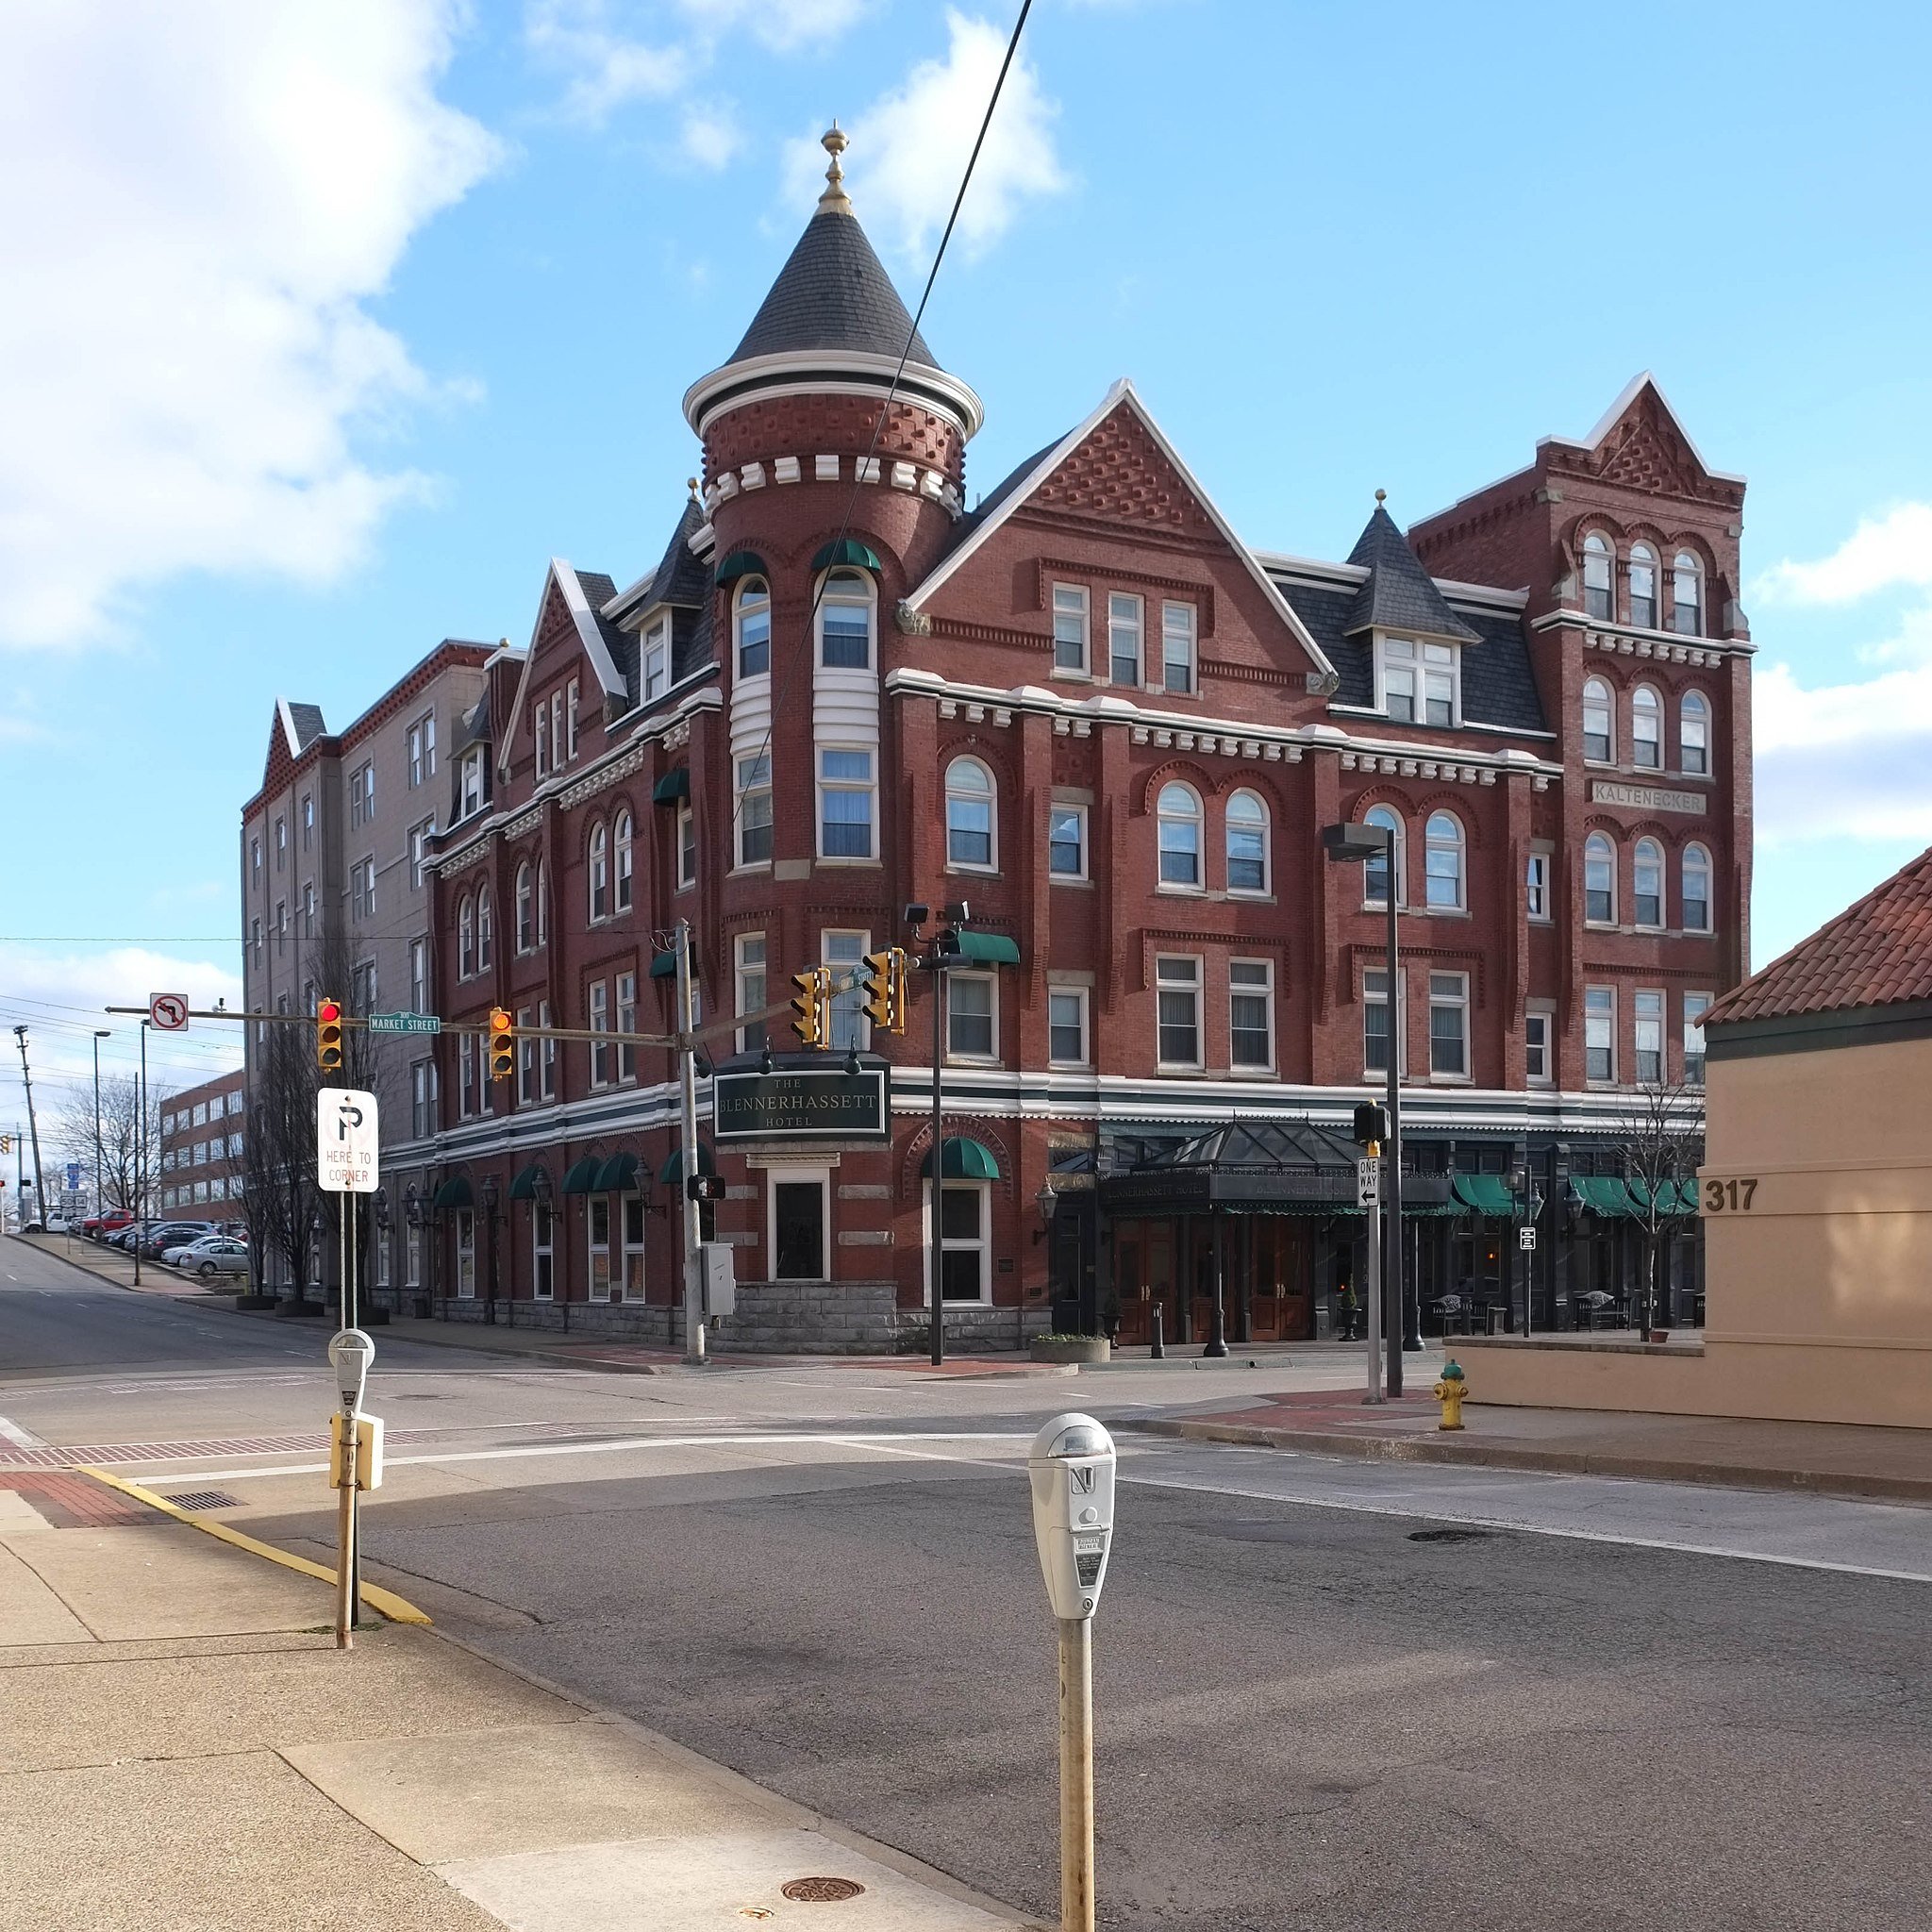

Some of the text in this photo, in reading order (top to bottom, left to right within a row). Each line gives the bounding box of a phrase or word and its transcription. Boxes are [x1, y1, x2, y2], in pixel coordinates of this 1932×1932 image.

[372, 1019, 437, 1031] MARKET STREET
[774, 1078, 802, 1089] THE
[720, 1094, 876, 1114] BLENNERHASSETT
[766, 1117, 812, 1127] HOTEL
[326, 1150, 371, 1165] HERE TO
[1359, 1160, 1376, 1174] ONE
[328, 1169, 369, 1183] CORNER
[1359, 1174, 1377, 1188] WAY
[1705, 1179, 1757, 1212] 317
